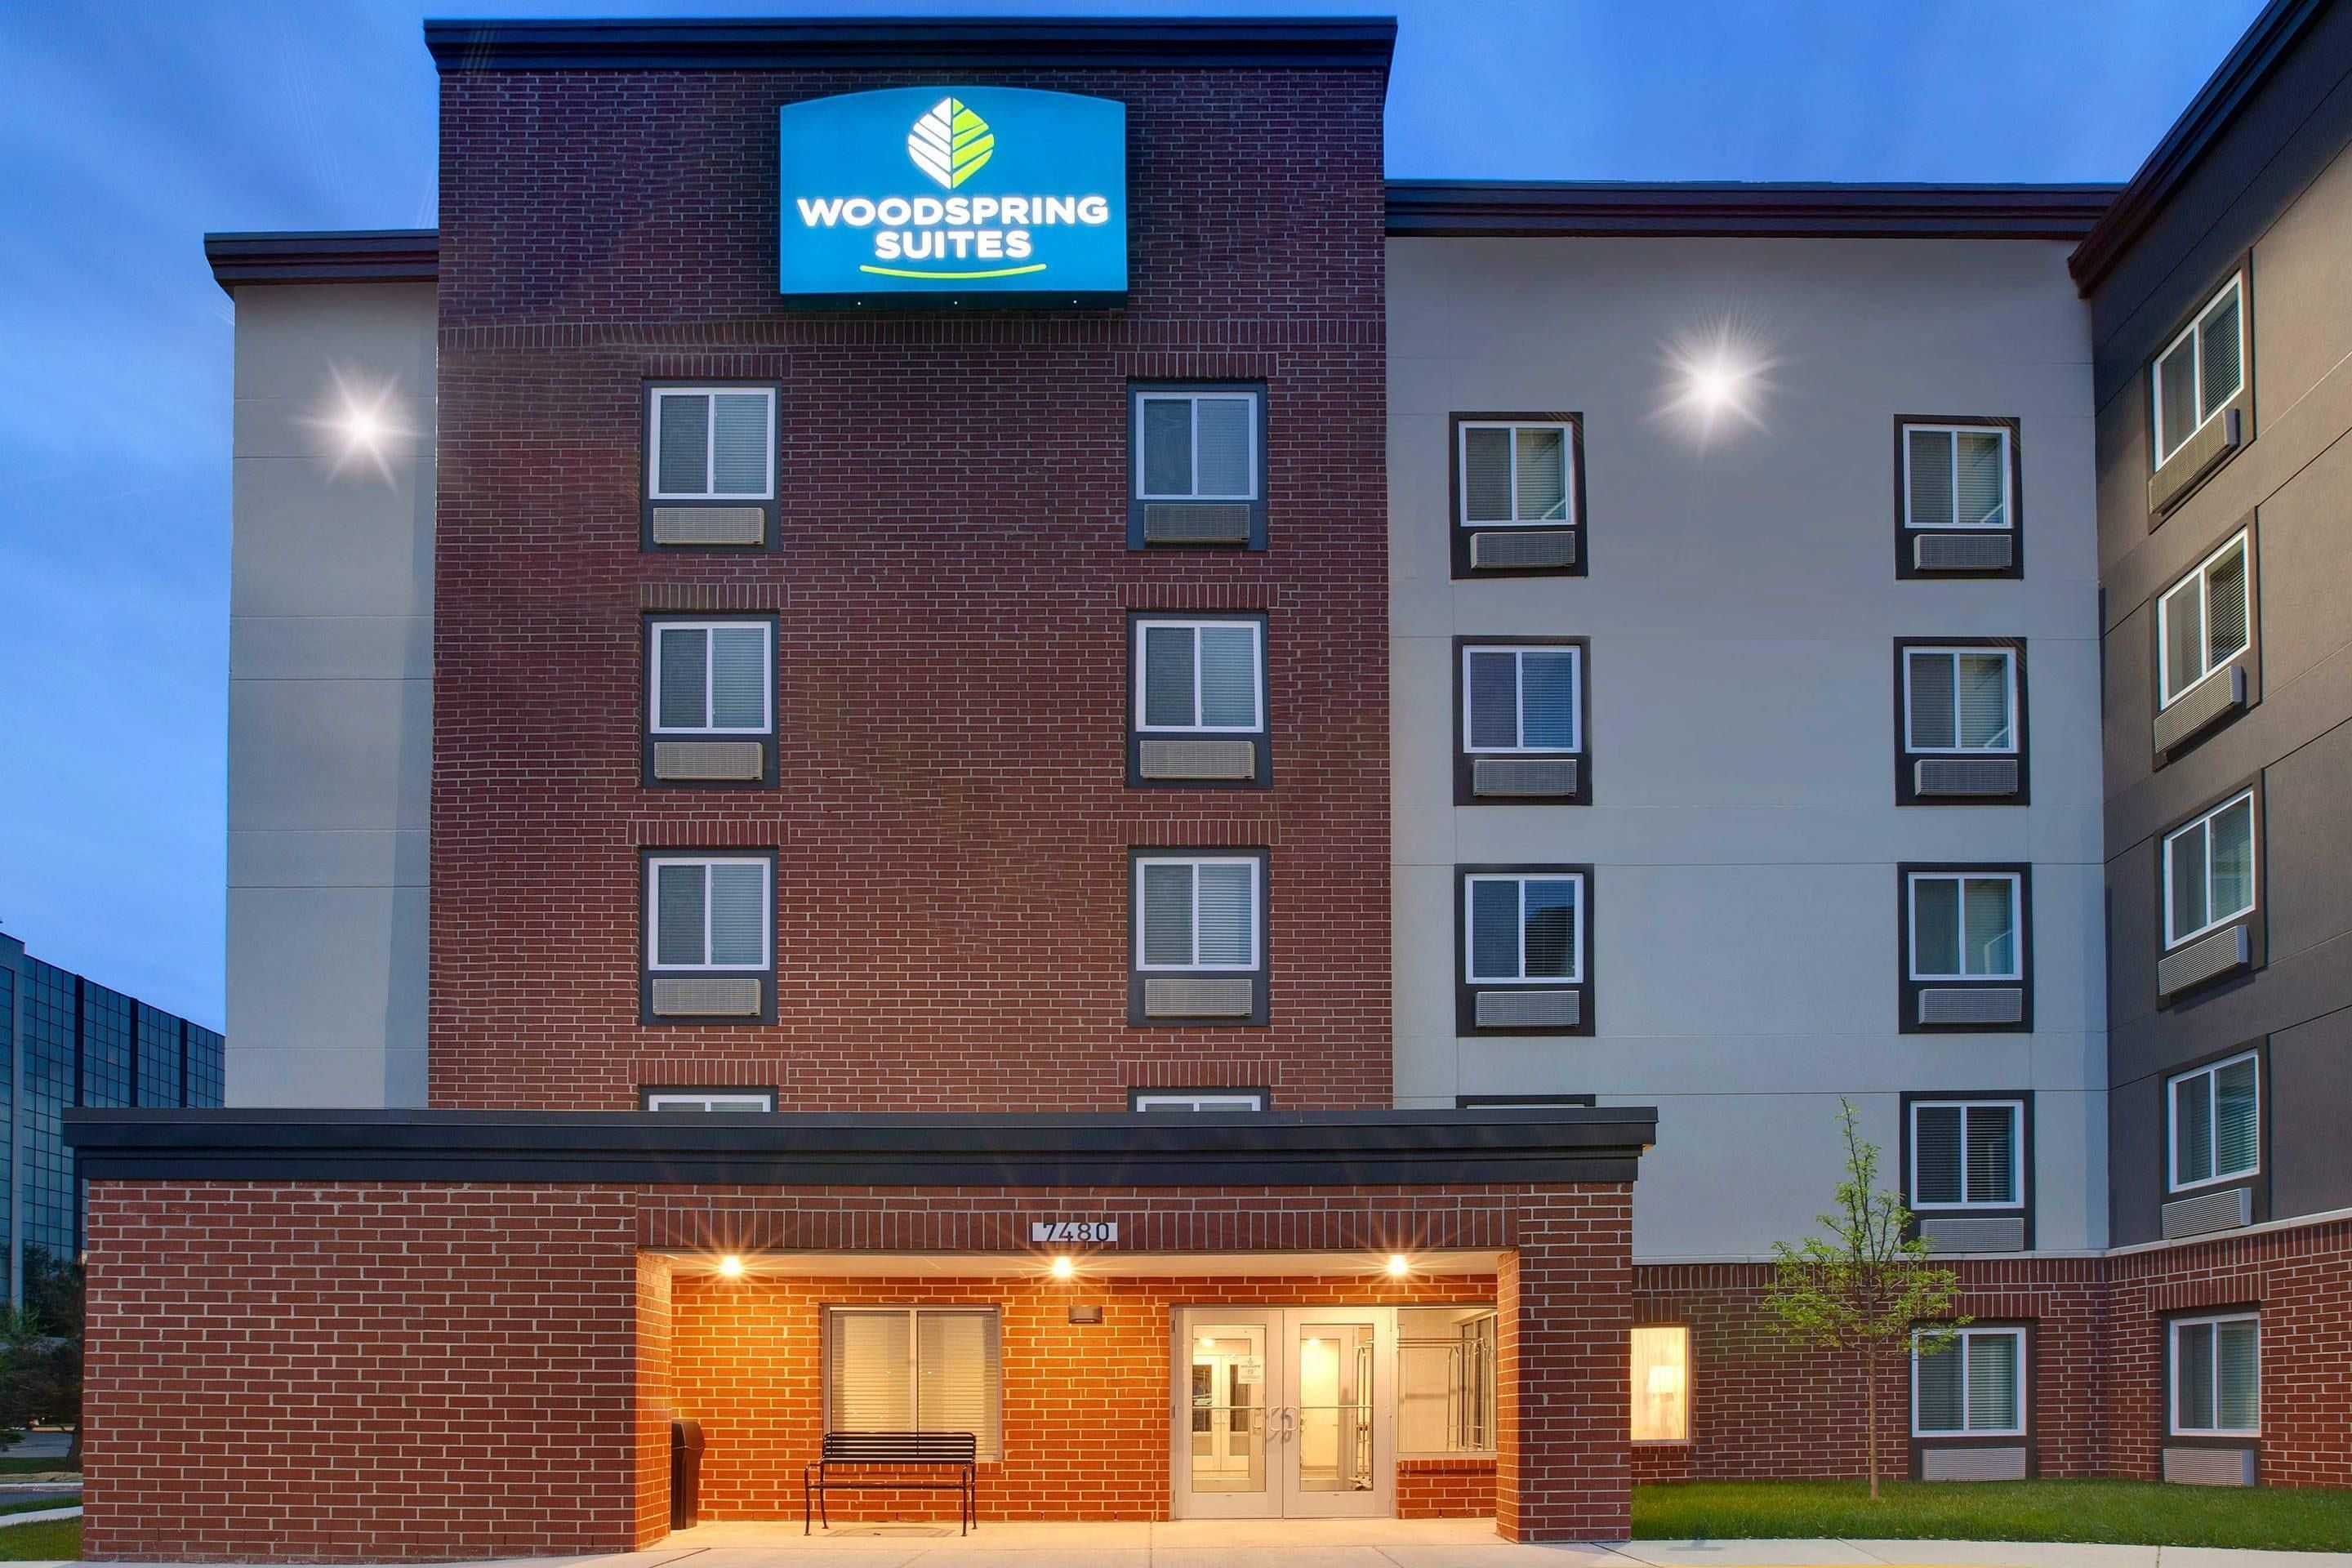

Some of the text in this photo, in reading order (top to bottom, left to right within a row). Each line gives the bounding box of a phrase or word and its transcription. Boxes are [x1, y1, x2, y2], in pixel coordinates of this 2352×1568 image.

[797, 196, 1109, 226] WOODSPRING
[875, 230, 1032, 259] SUITES
[1043, 1223, 1109, 1241] 7480
